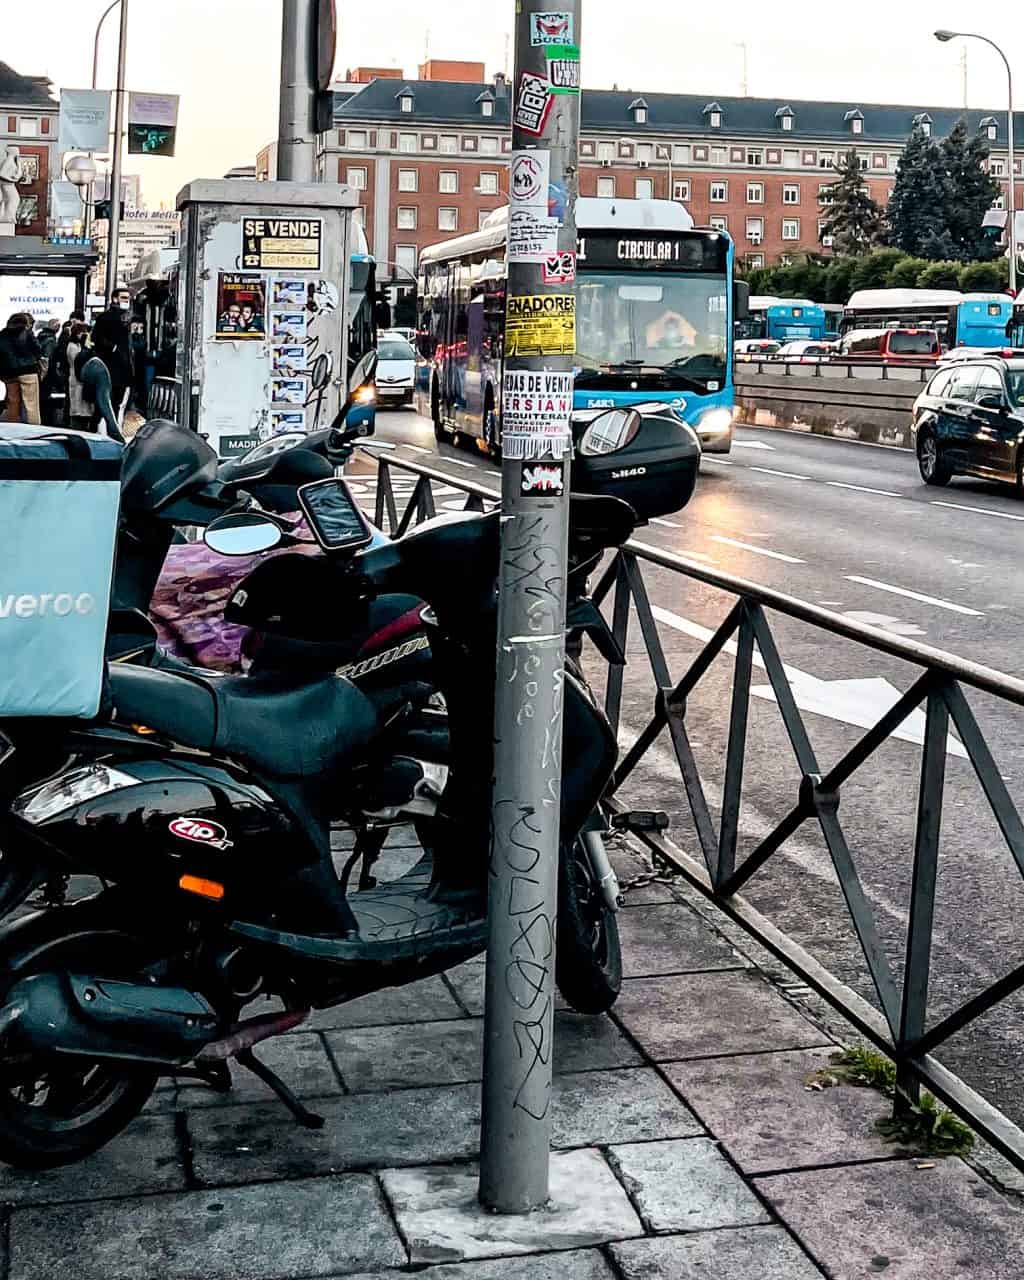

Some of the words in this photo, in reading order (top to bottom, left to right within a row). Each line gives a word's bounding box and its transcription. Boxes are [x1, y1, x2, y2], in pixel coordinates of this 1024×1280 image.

[245, 220, 265, 237] SE
[268, 220, 320, 238] VENDE
[617, 240, 673, 260] CIRCULAR
[674, 241, 680, 260] 1
[528, 375, 542, 392] DE
